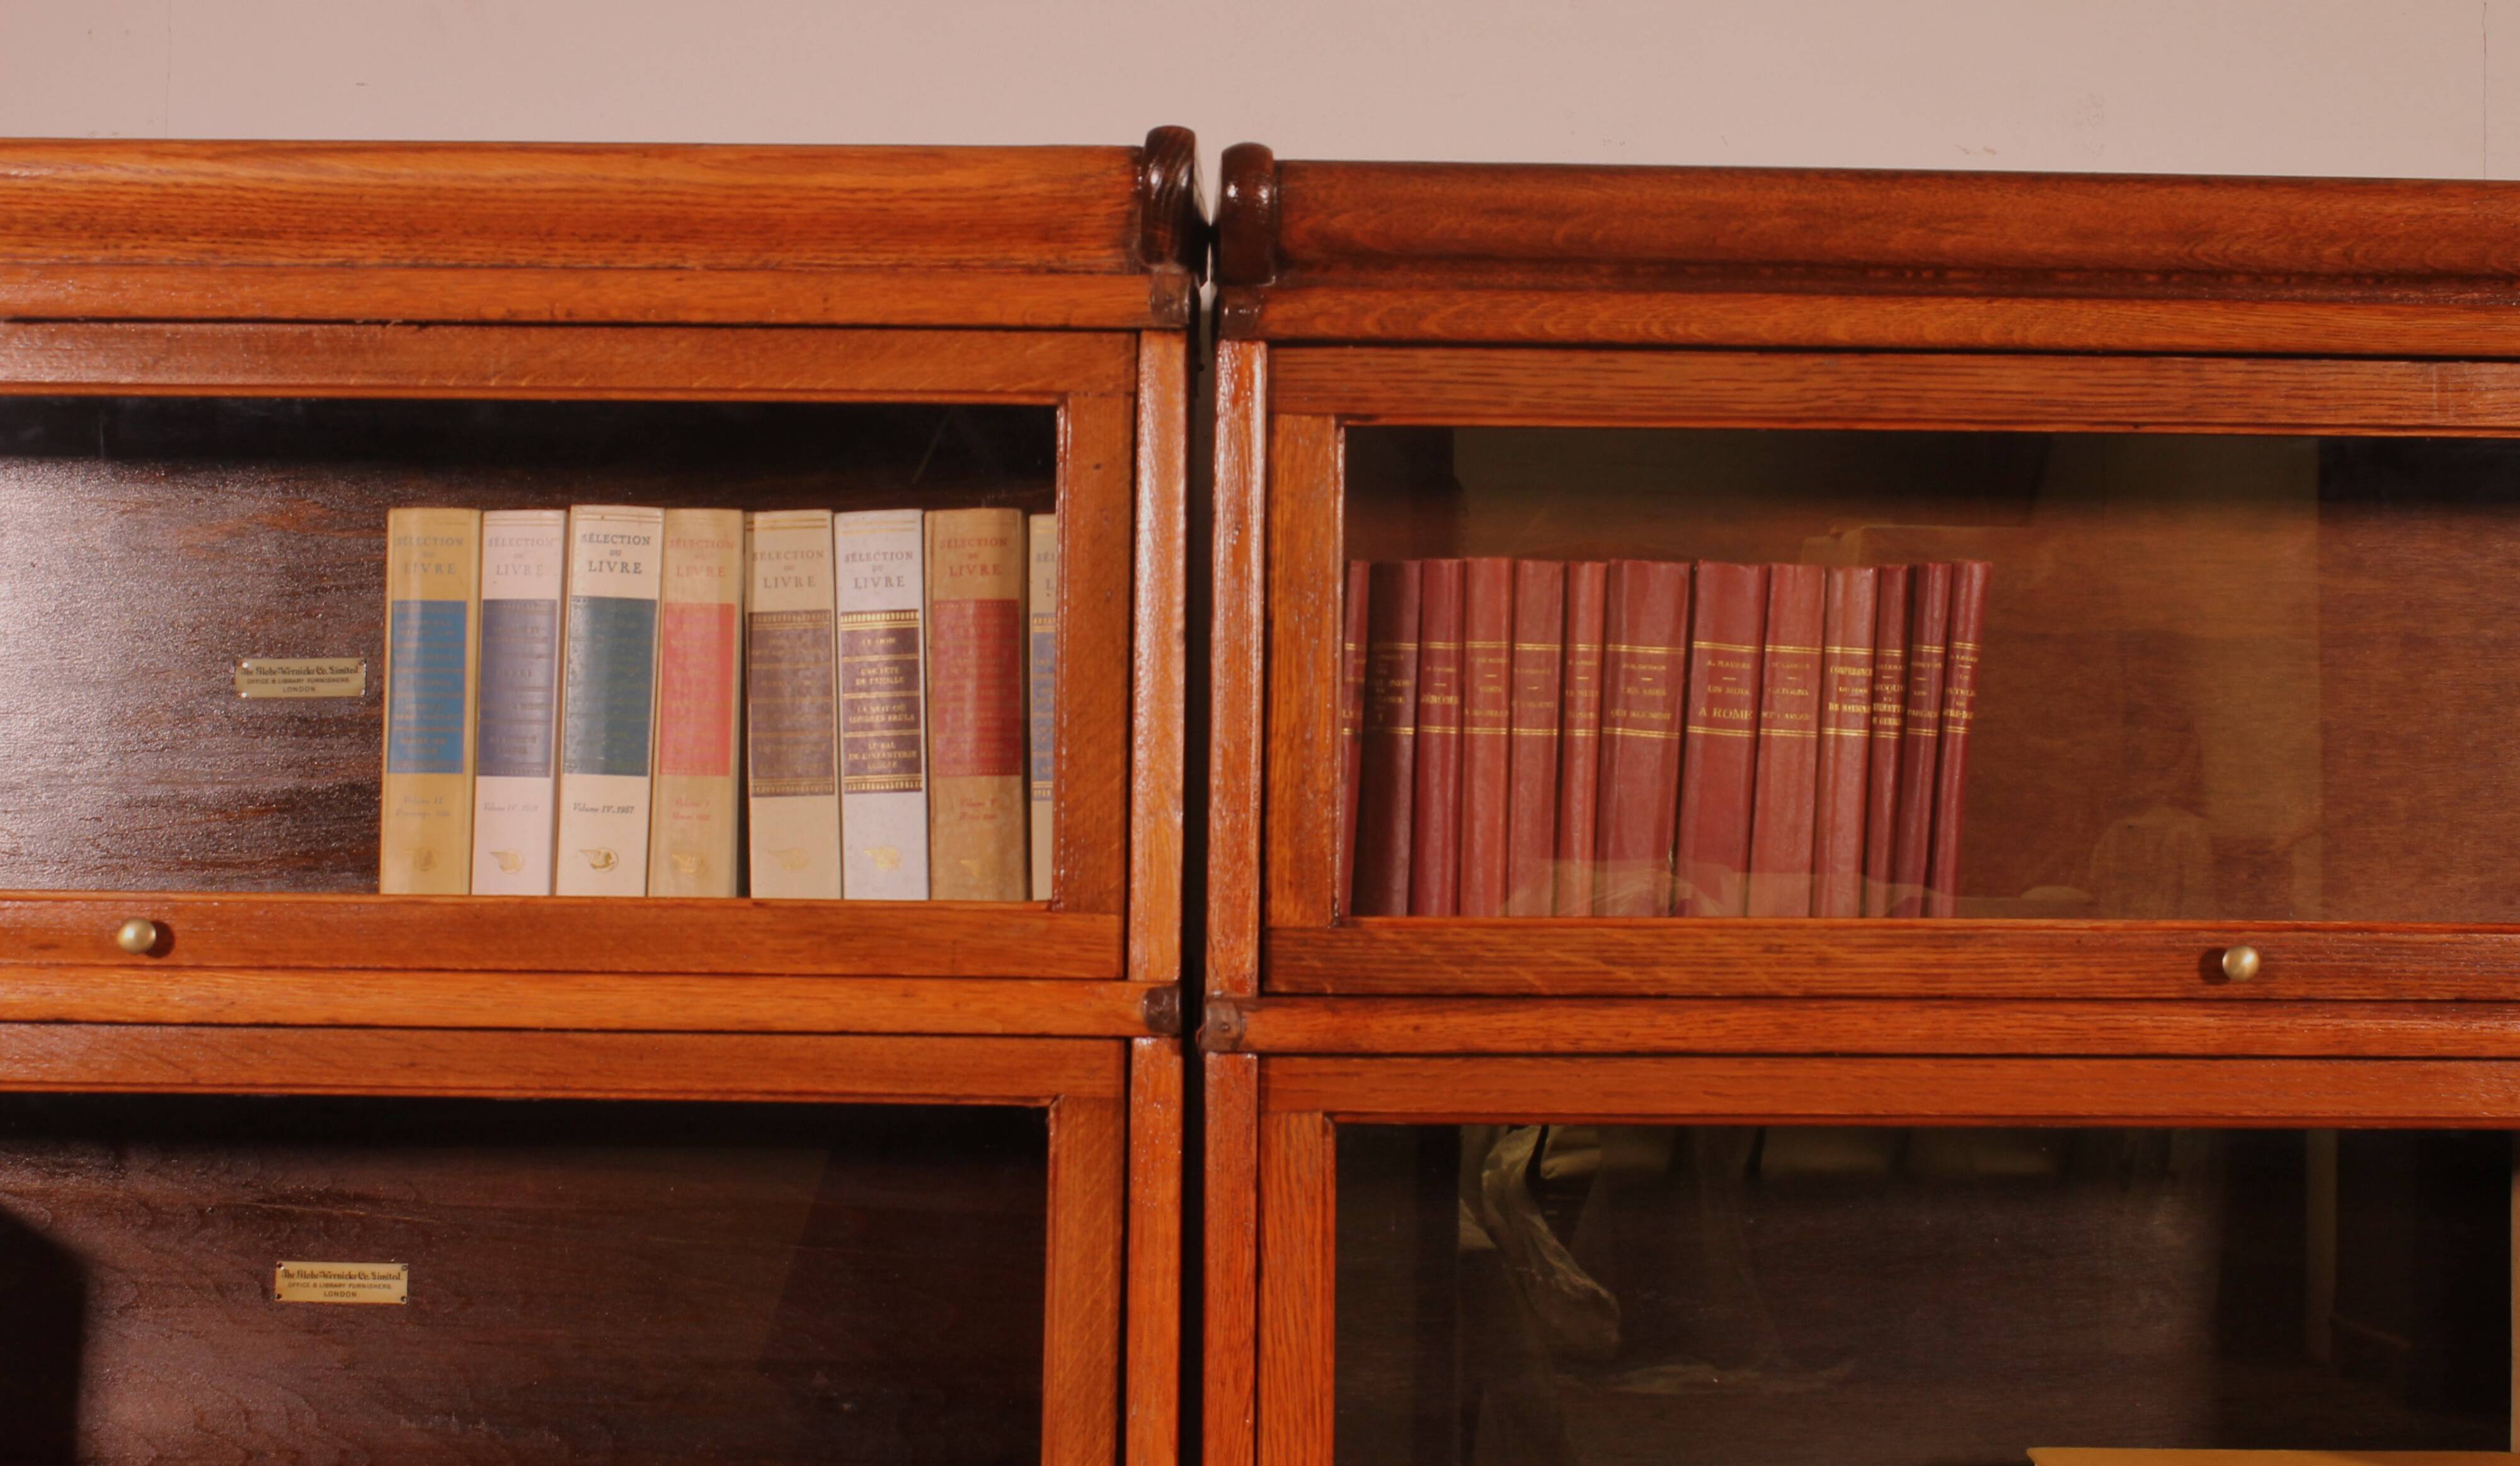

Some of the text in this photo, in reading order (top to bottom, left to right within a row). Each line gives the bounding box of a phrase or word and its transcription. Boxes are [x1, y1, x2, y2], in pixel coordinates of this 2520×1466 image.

[581, 532, 651, 546] SÉLECTION
[403, 562, 457, 575] LIVRE
[495, 563, 545, 576] LIVRE
[588, 560, 643, 575] LIVRE
[675, 564, 726, 578] LIVRE
[948, 563, 1002, 578] LIVRE
[763, 575, 817, 589] LIVRE
[854, 575, 906, 590] LIVRE
[1698, 707, 1754, 720] A ROME
[573, 802, 599, 813] Volume
[284, 1269, 295, 1280] The
